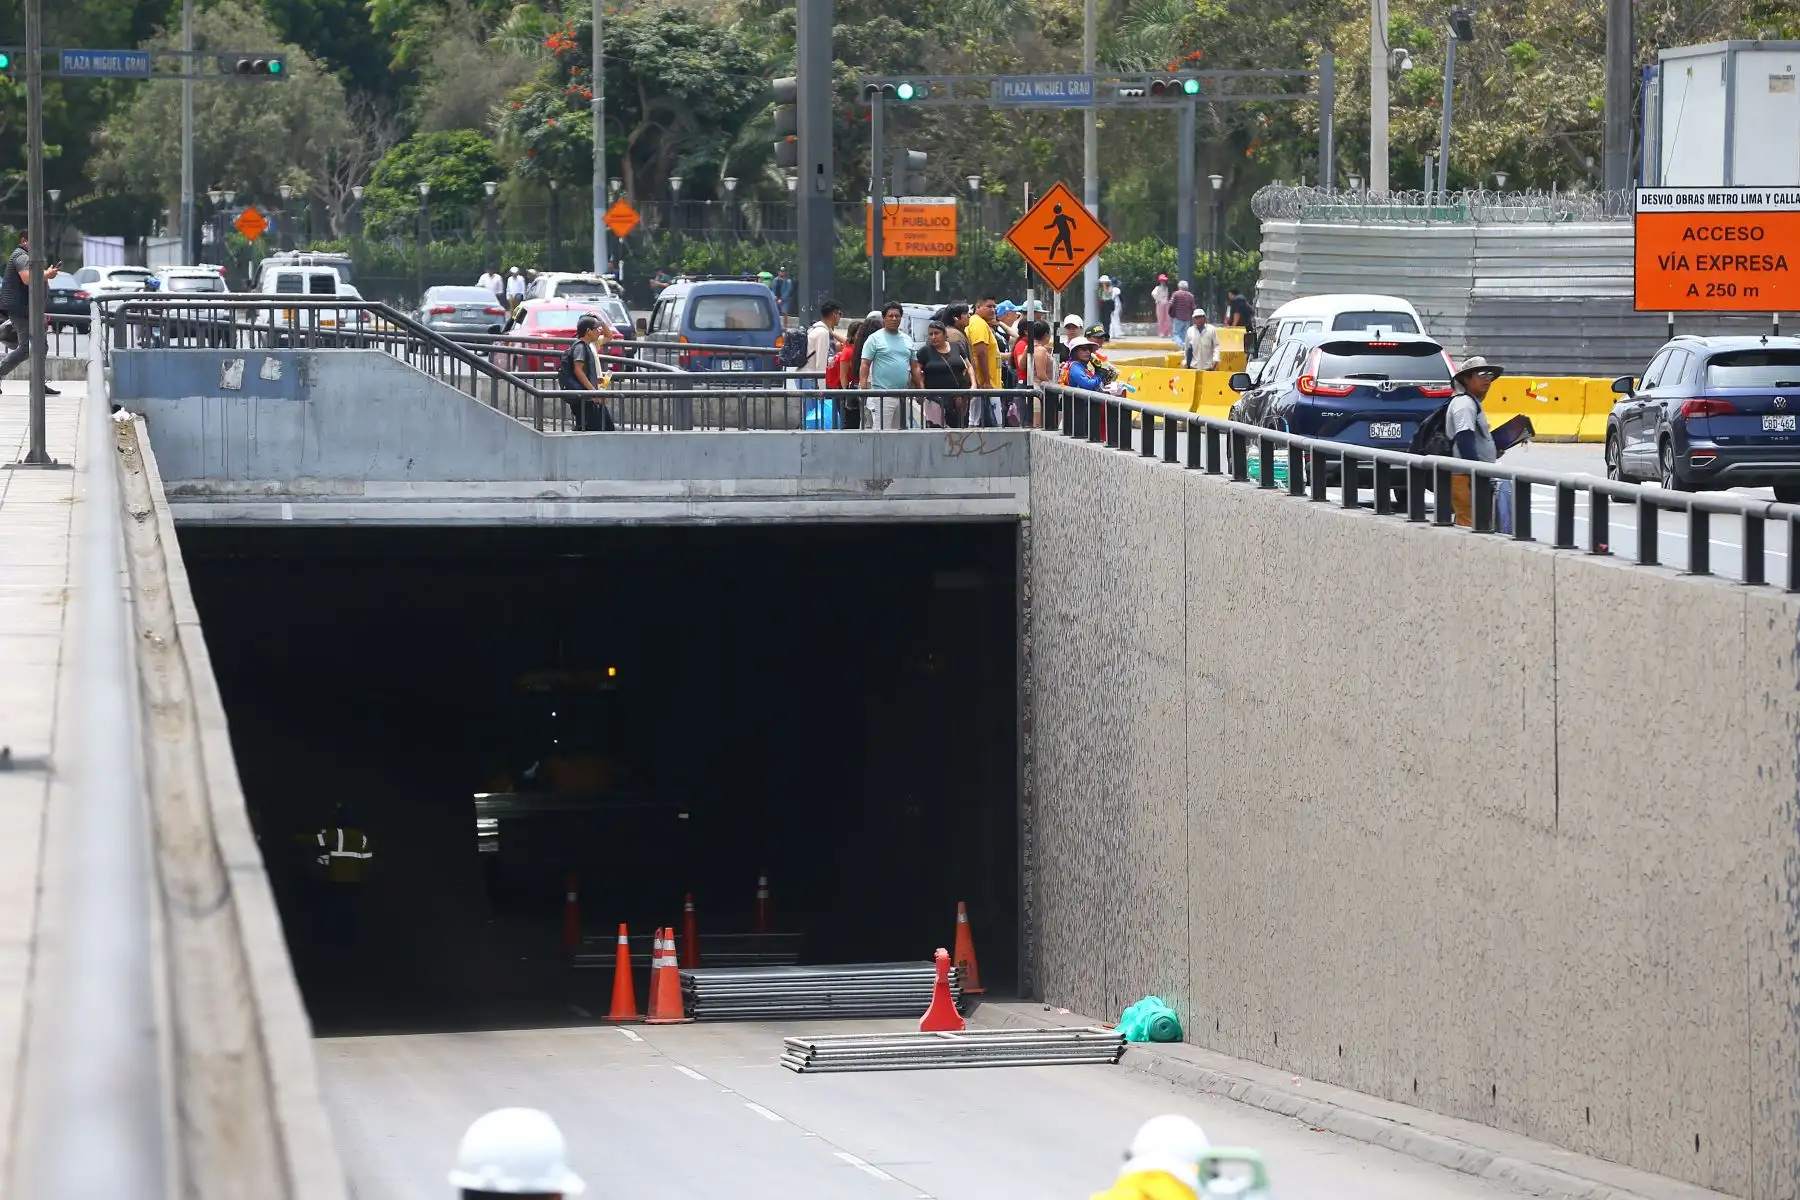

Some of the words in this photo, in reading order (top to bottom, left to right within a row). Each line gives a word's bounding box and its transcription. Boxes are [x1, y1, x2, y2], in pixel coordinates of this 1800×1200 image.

[64, 55, 90, 71] PLAZA
[92, 56, 121, 72] MIGUEL
[125, 56, 146, 72] GRAU
[1004, 81, 1032, 96] PLAZA
[1034, 80, 1065, 95] MIGUEL
[1068, 80, 1091, 95] GRAU
[1641, 193, 1674, 205] DESVIO
[1676, 193, 1705, 205] OBRAS
[1708, 193, 1738, 205] METRO
[1741, 193, 1763, 204] LIMA
[1766, 193, 1771, 204] Y
[1774, 193, 1800, 204] CALLA
[1682, 226, 1765, 241] ACCESO
[905, 242, 954, 253] PRIVADO
[1658, 251, 1690, 271] VÍA
[1696, 255, 1789, 271] EXPRESA
[1686, 283, 1700, 297] A
[1706, 283, 1737, 297] 250
[1743, 285, 1759, 297] m
[1763, 419, 1795, 429] CBD-462
